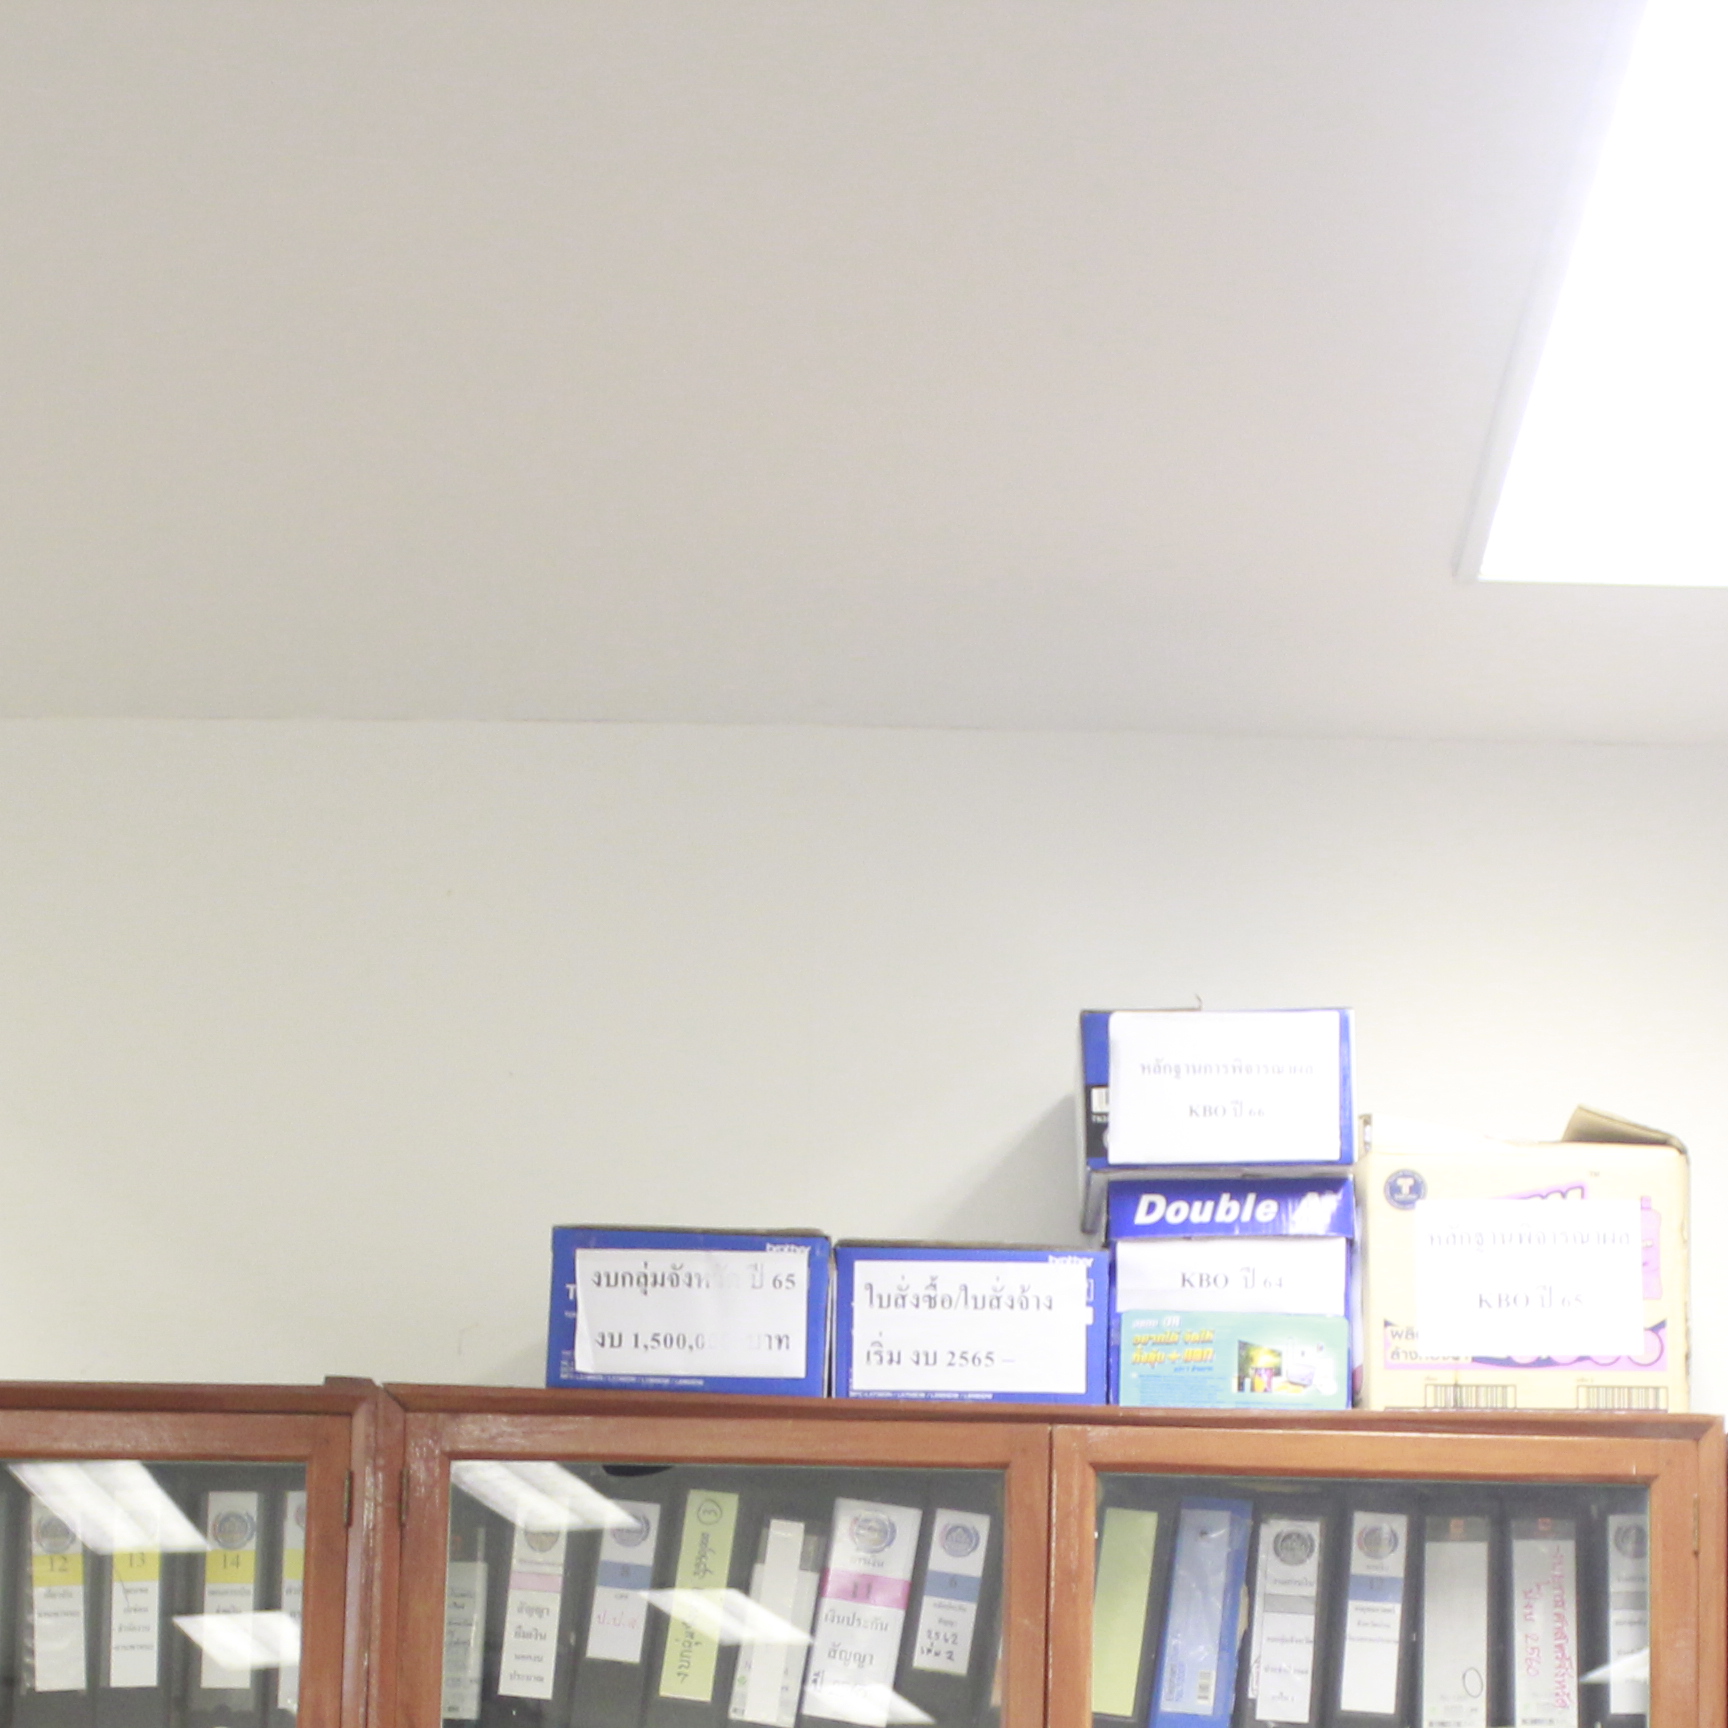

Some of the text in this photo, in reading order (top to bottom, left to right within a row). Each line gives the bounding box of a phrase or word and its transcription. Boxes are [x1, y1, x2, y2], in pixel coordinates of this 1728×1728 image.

[1188, 1104, 1227, 1118] KBO
[1134, 1192, 1280, 1225] Double
[772, 1274, 797, 1290] 65
[1180, 1271, 1230, 1290] KBO
[1478, 1293, 1530, 1309] KBO
[595, 1332, 623, 1350] งบ
[865, 1331, 902, 1366] เริ่ม
[909, 1350, 939, 1366] งบ
[946, 1350, 996, 1367] 2565
[47, 1556, 68, 1573] 12
[221, 1553, 241, 1570] 14
[827, 1641, 875, 1669] สัญญา
